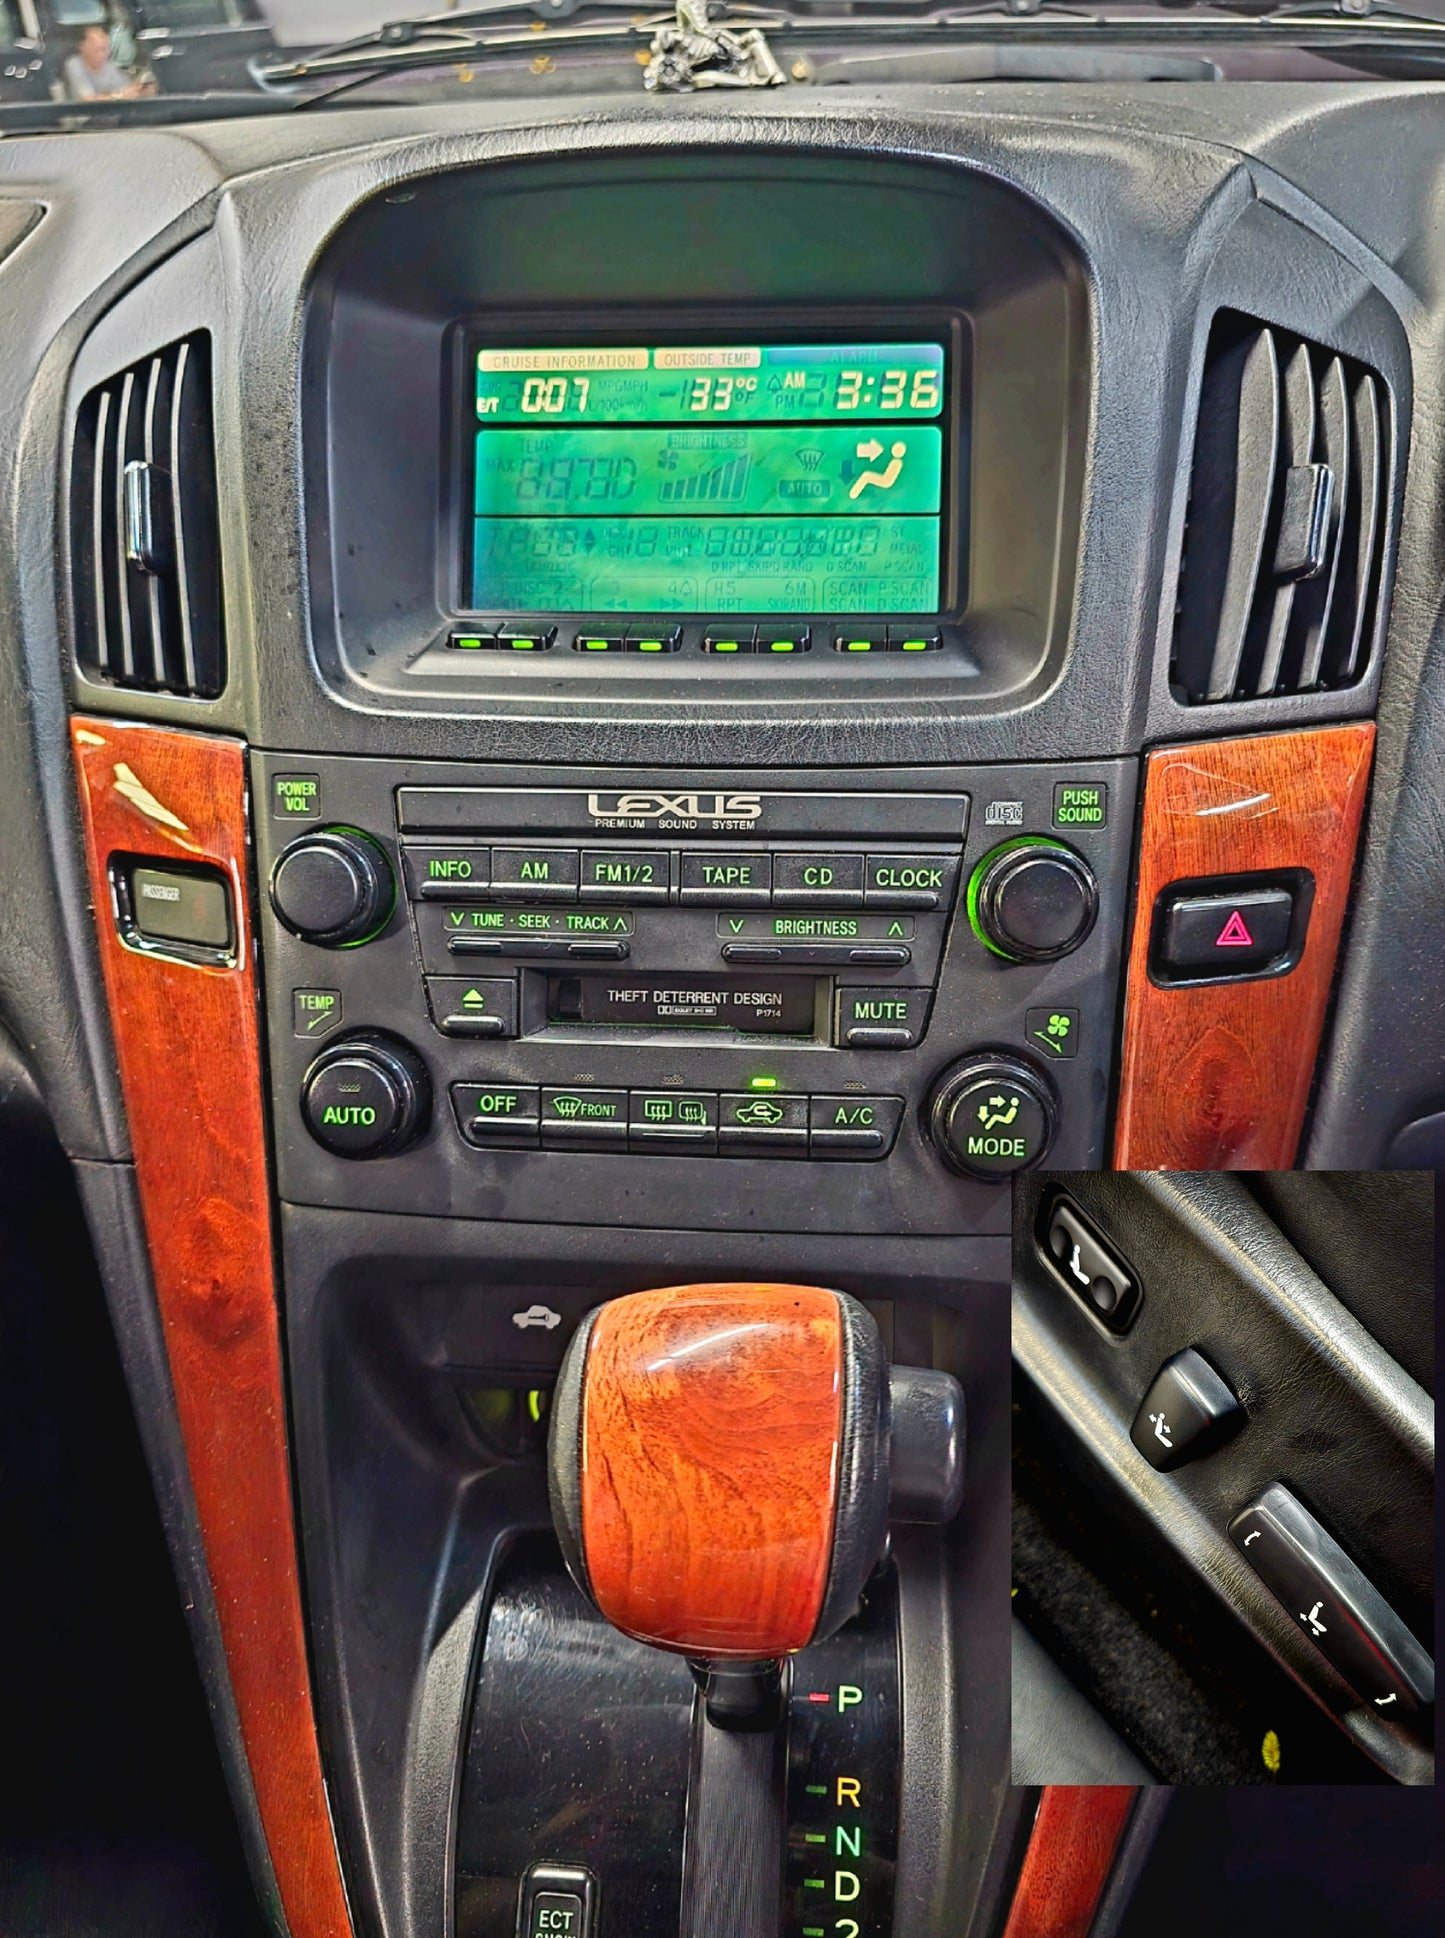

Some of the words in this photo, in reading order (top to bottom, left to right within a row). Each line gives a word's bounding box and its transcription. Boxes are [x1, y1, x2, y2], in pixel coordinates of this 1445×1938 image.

[494, 356, 539, 369] CRUISE
[547, 355, 636, 369] INFORMATION
[664, 353, 714, 366] OUTSIDE
[721, 352, 751, 366] TEMP
[783, 371, 806, 389] AM
[836, 370, 939, 410] 3:36
[277, 781, 317, 797] POWER
[1063, 790, 1099, 806] PUSH
[285, 797, 311, 812] VOL
[588, 794, 763, 819] LEXUS
[594, 819, 646, 829] PREMIUM
[658, 819, 698, 829] SOUND
[712, 820, 756, 830] SYSTEM
[1058, 807, 1103, 823] SOUND
[429, 860, 473, 879] INFO
[520, 861, 549, 880] AM
[594, 864, 654, 884] FM1/2
[702, 866, 752, 886] TAPE
[803, 866, 834, 886] CD
[875, 867, 943, 889] CLOCK
[471, 913, 505, 928] TUNE
[517, 913, 552, 929] SEEK
[566, 915, 610, 931] TRACK
[773, 918, 858, 937] BRIGHTNESS
[299, 994, 336, 1010] TEMP
[607, 989, 649, 1003] THEFT
[653, 990, 730, 1005] DETERRENT
[733, 992, 783, 1006] DESIGN
[756, 1008, 782, 1018] P1714
[854, 1001, 908, 1020] MUTE
[479, 1094, 518, 1113] OFF
[580, 1102, 618, 1118] FRONT
[322, 1105, 376, 1127] AUTO
[834, 1106, 874, 1125] A/C
[967, 1136, 1026, 1158] MODE
[837, 1685, 863, 1714] P
[836, 1776, 861, 1808] R
[836, 1825, 860, 1858] N
[835, 1870, 860, 1902] D
[539, 1909, 575, 1930] ECT
